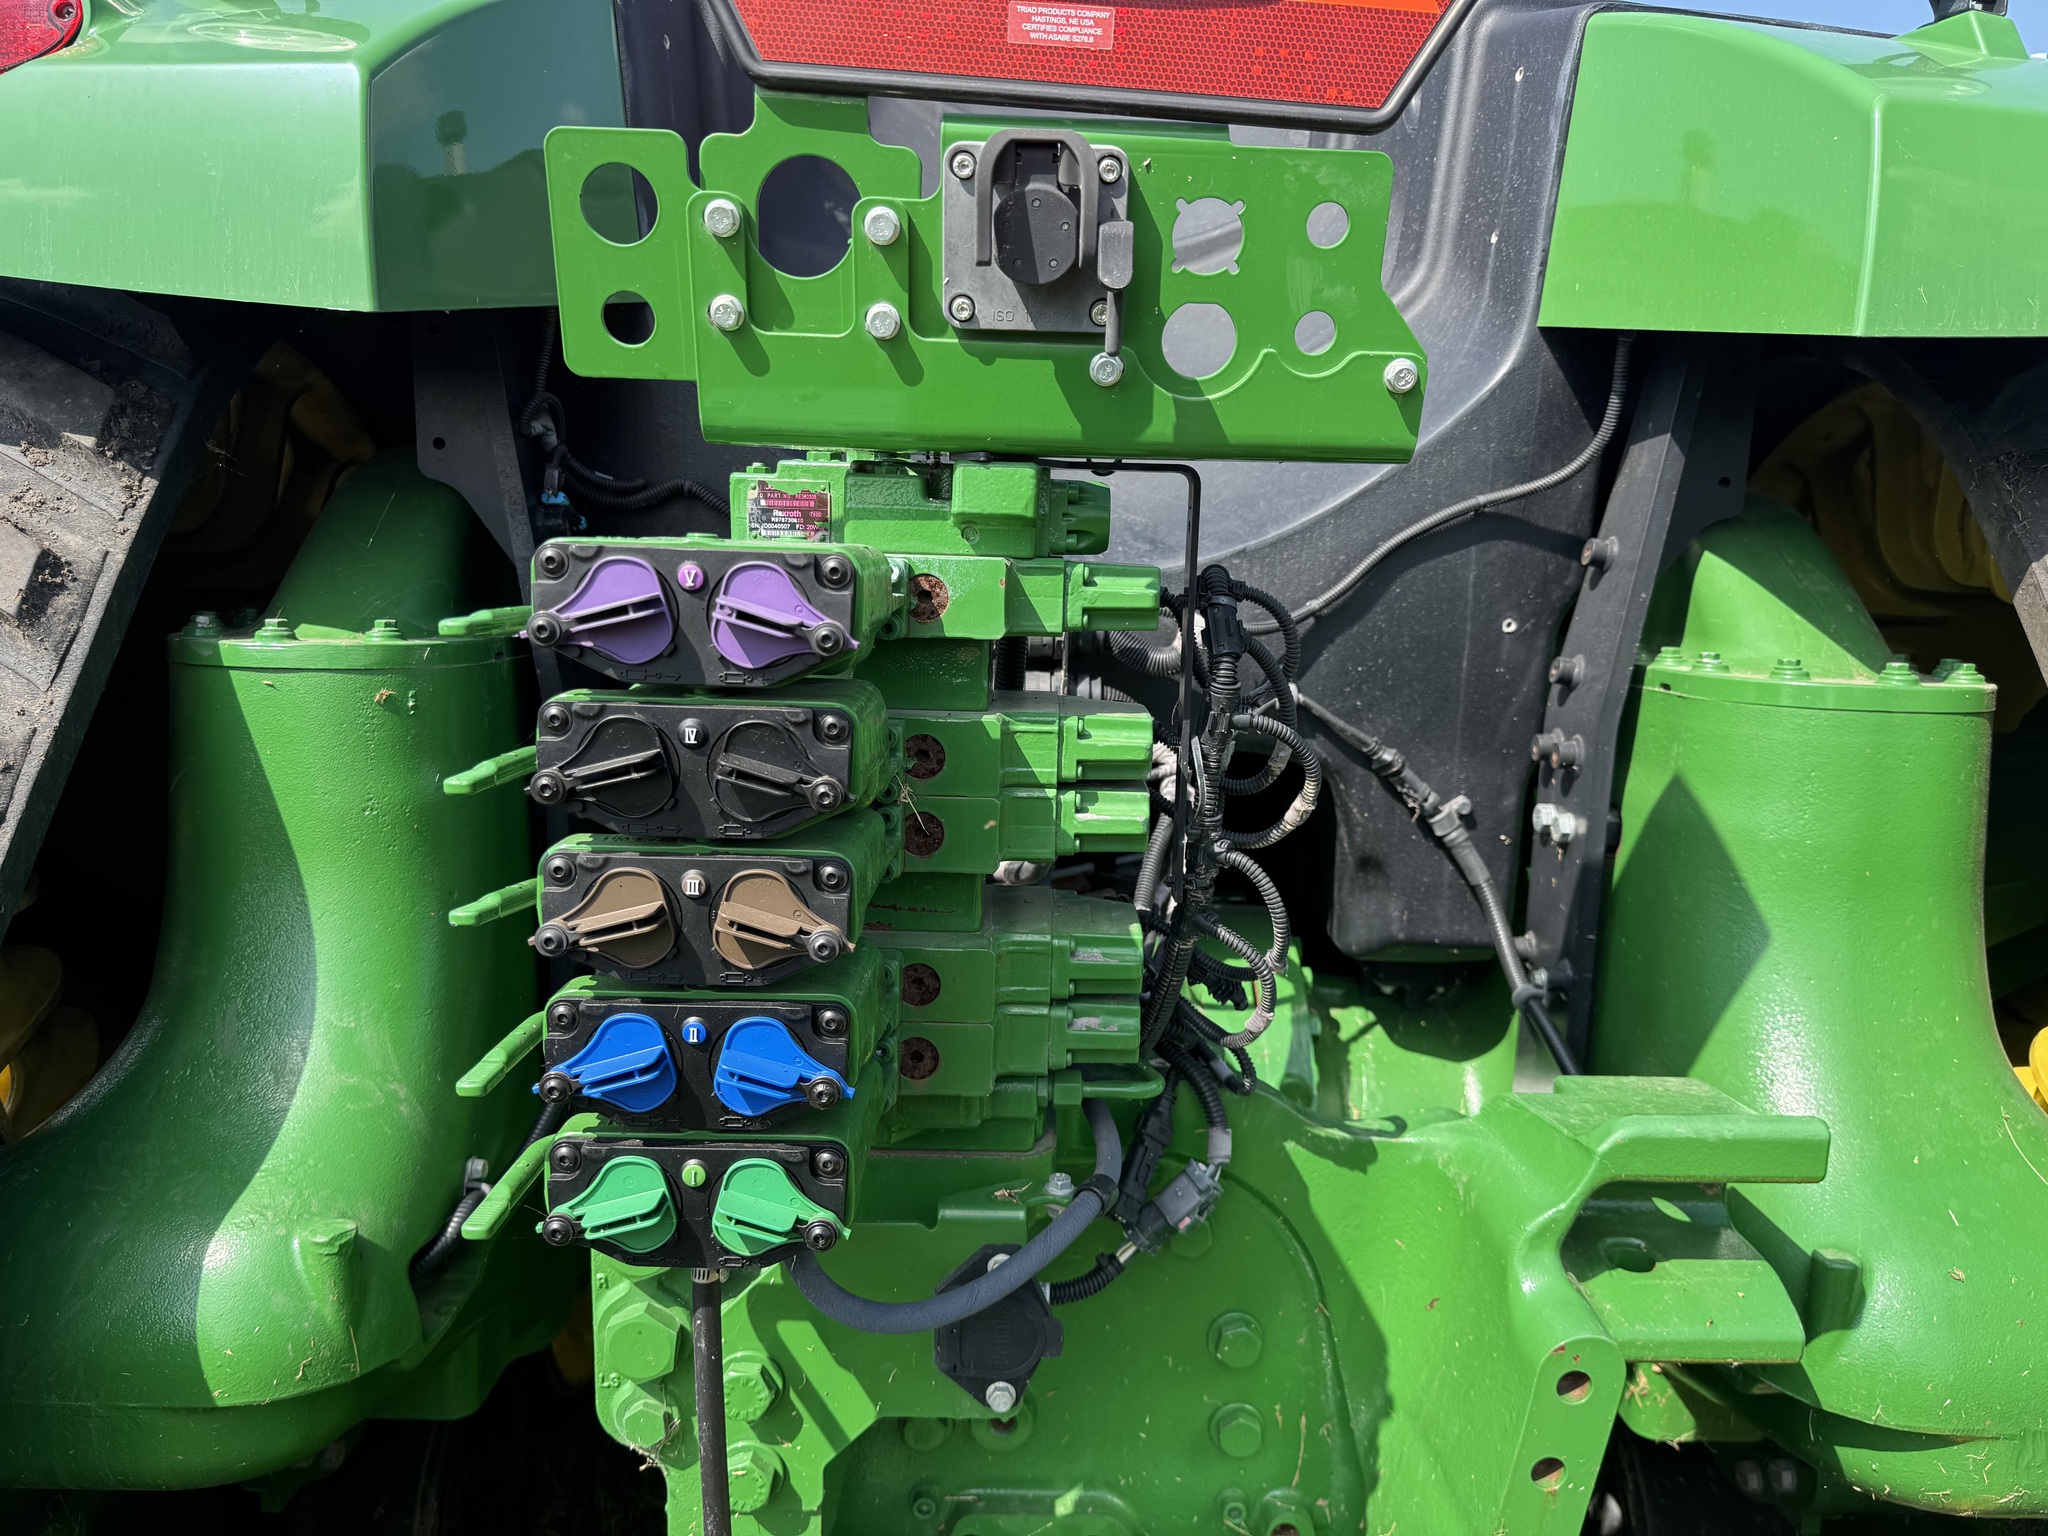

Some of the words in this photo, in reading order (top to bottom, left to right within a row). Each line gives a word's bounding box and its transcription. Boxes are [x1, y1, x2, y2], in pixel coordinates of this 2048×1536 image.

[1016, 6, 1037, 14] TRIAD
[1038, 7, 1076, 16] PRODUCTS
[1077, 10, 1111, 18] COMPANY
[1032, 16, 1068, 25] HASTINGS,
[1080, 18, 1095, 26] USA
[1022, 23, 1057, 32] CERTIFIES
[1058, 26, 1103, 35] COMPLIANCE
[1030, 32, 1048, 40] WITH
[992, 310, 1015, 322] ISO
[773, 509, 801, 518] Rexroth
[683, 569, 697, 587] V
[684, 727, 698, 744] IV
[686, 879, 700, 895] III
[688, 1027, 699, 1043] II
[598, 1372, 621, 1388] LS
